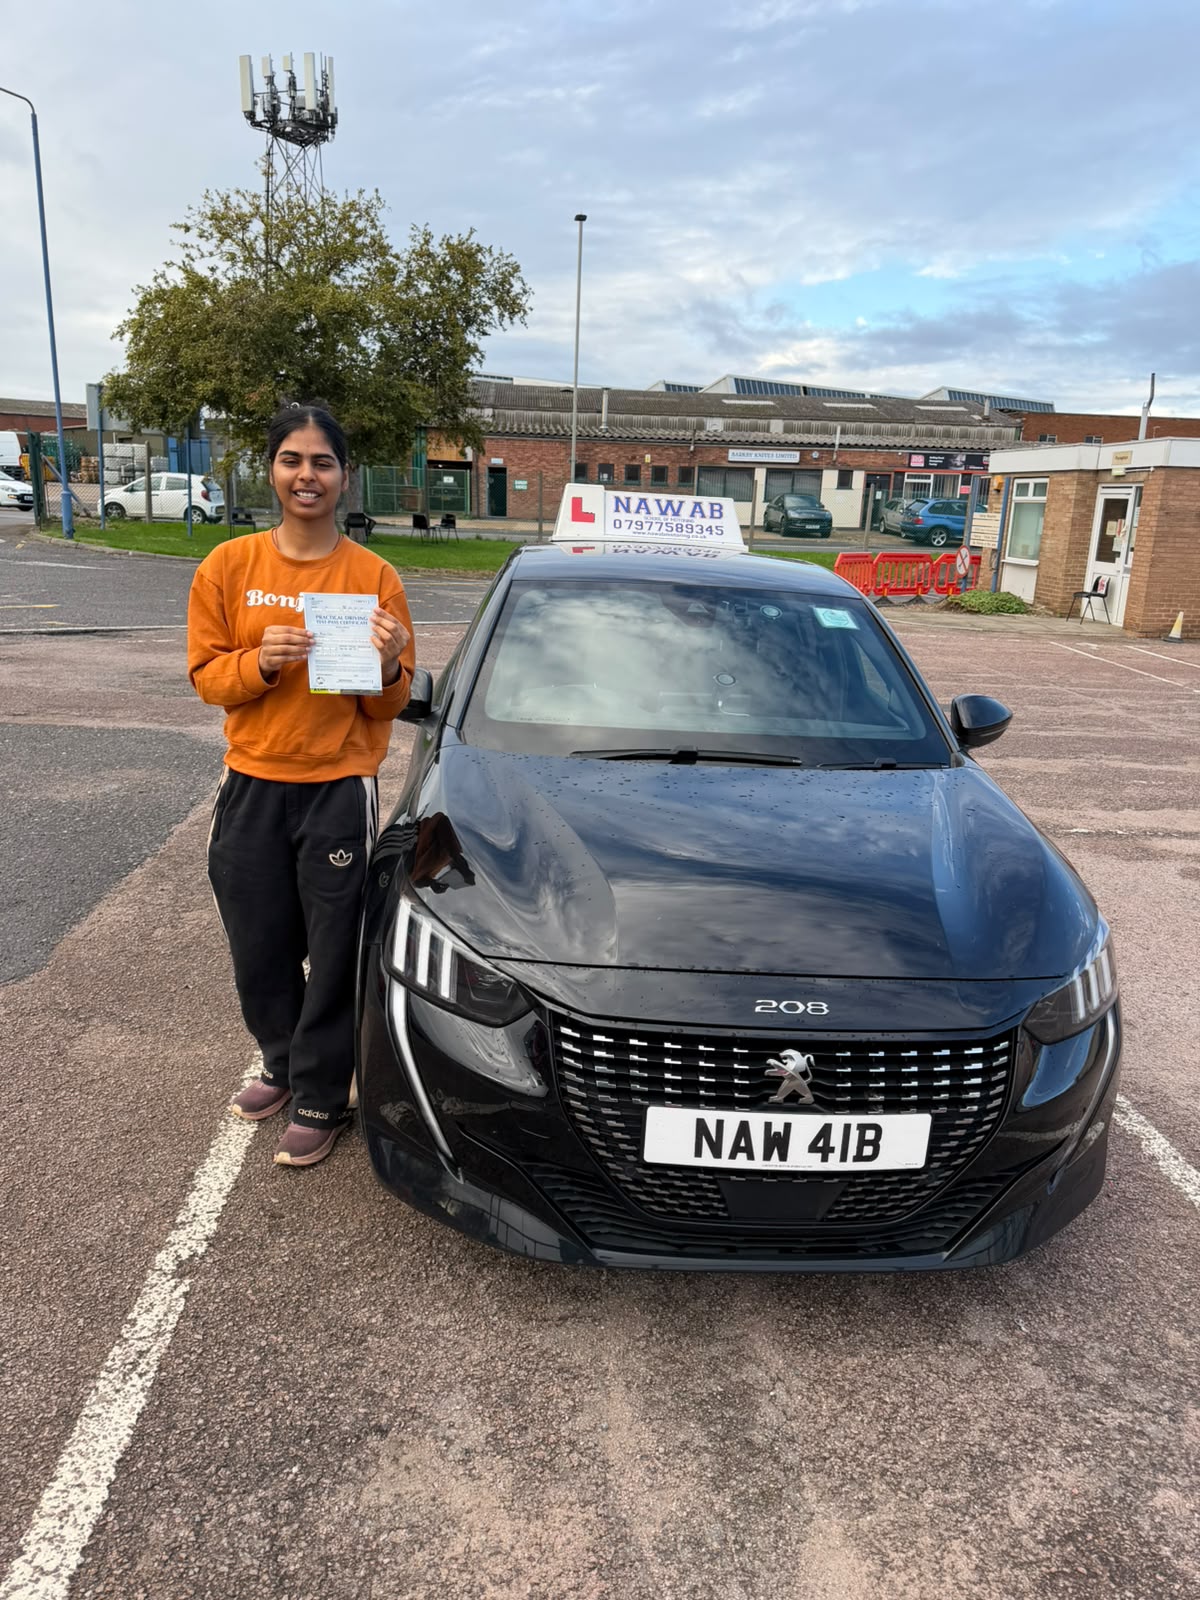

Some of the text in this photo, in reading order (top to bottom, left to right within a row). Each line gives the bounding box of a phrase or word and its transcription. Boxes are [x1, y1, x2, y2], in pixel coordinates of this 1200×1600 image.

[572, 497, 595, 523] L
[613, 496, 723, 519] NAWAB
[614, 519, 724, 535] 07977589345
[755, 1000, 829, 1015] 208
[298, 1108, 329, 1120] adidas
[694, 1117, 883, 1163] NAW 41B
